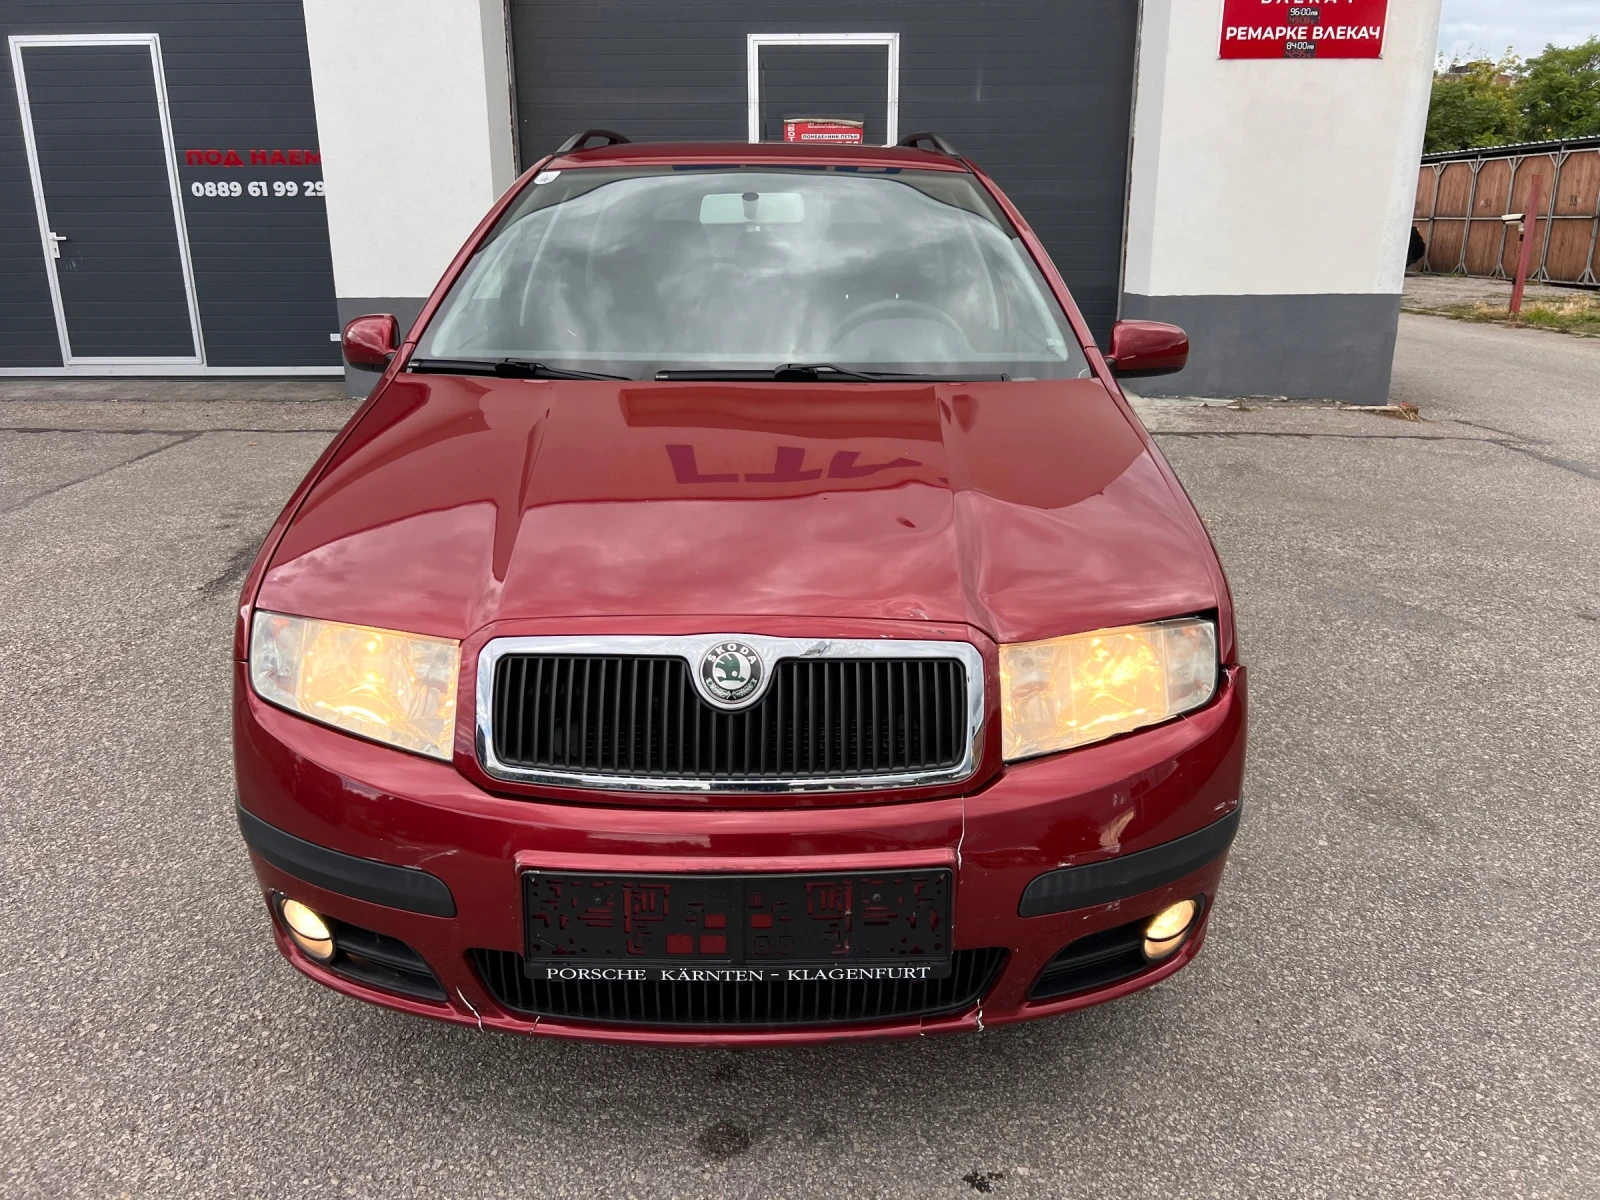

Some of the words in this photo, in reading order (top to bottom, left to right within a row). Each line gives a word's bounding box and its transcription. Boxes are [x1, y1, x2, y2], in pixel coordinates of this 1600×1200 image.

[1226, 26, 1308, 40] РЕМАРКЕ
[1312, 26, 1381, 39] ВЛЕКАЧ
[185, 149, 244, 167] ПОД
[250, 149, 322, 166] НАЕМ
[191, 181, 243, 197] 0889
[247, 181, 269, 197] 61
[272, 181, 299, 197] 99
[302, 181, 326, 197] 29
[546, 967, 646, 980] PORSCHE
[660, 968, 764, 982] KÄRNTEN
[787, 966, 931, 981] KLAGENFURT
